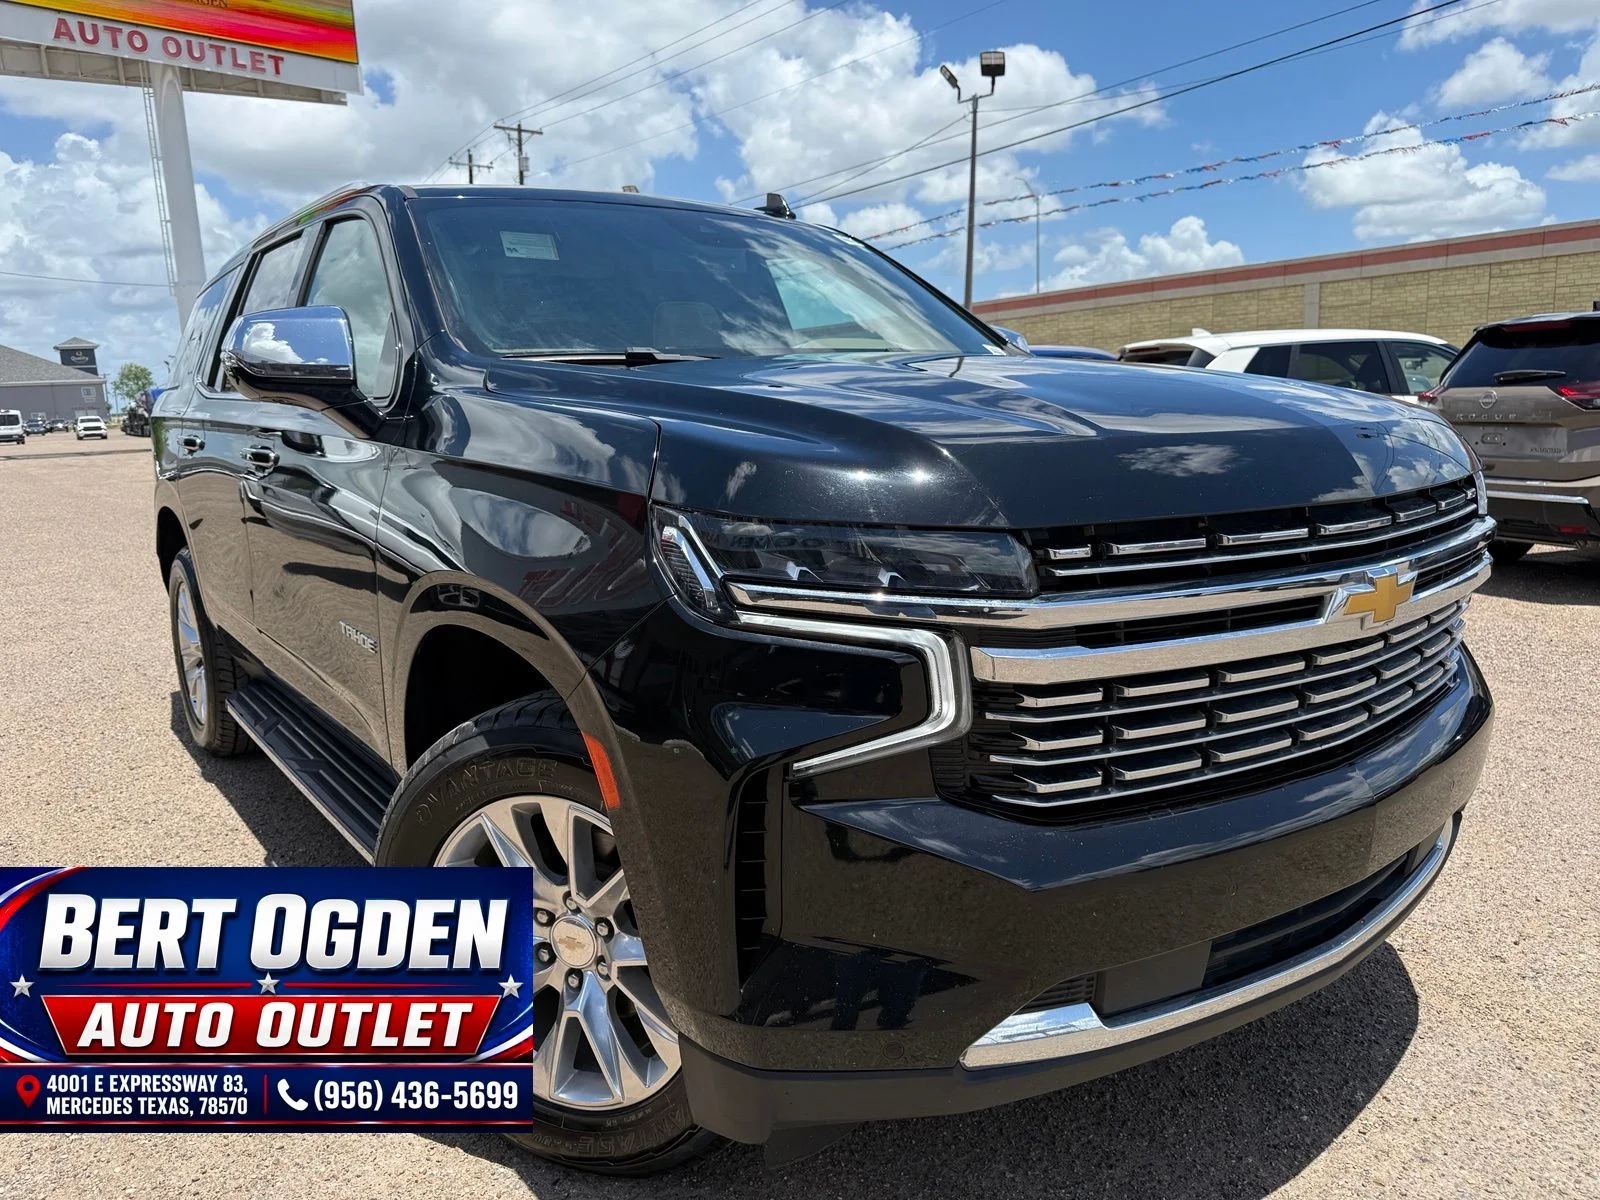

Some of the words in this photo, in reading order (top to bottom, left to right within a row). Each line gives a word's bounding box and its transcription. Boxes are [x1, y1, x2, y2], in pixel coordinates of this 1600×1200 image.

[53, 17, 149, 53] AUTO
[162, 35, 285, 76] OUTLET
[339, 620, 378, 653] TAHOE
